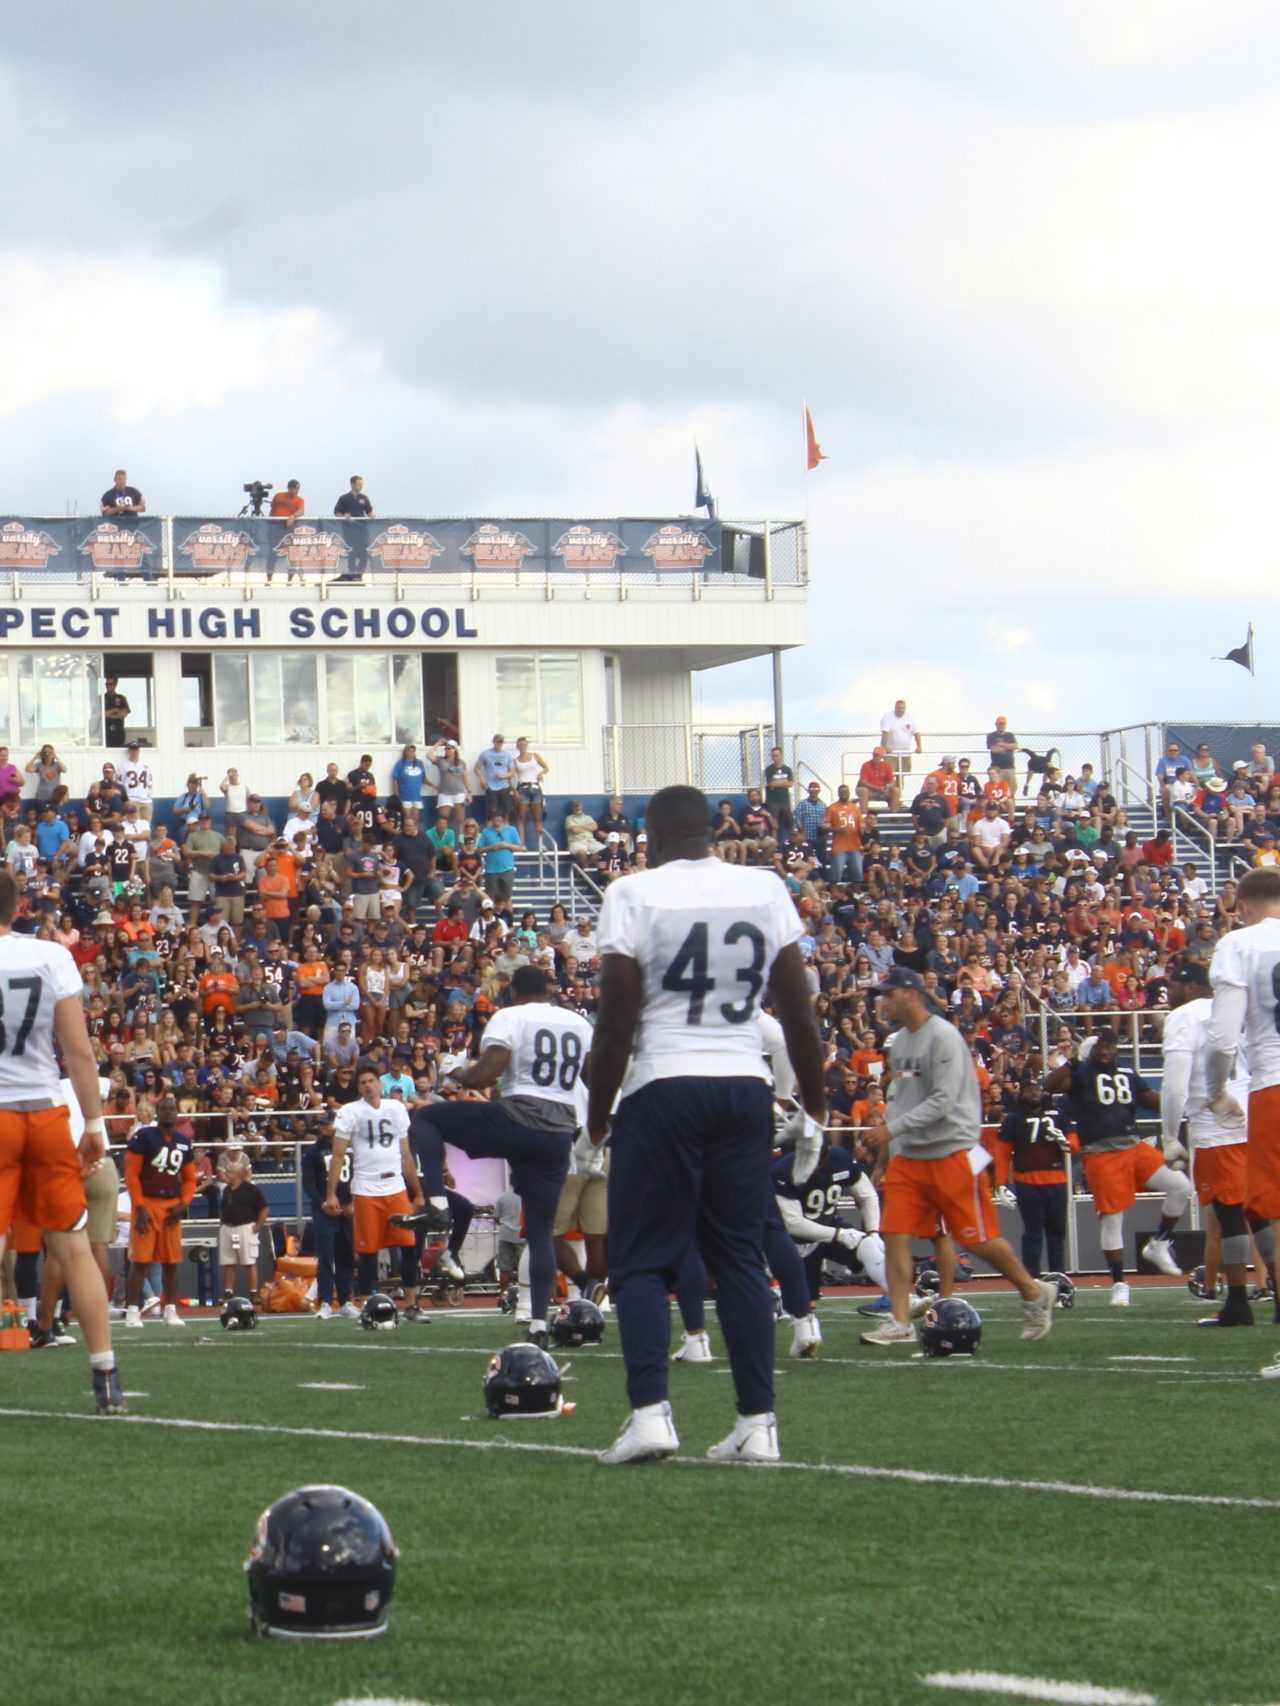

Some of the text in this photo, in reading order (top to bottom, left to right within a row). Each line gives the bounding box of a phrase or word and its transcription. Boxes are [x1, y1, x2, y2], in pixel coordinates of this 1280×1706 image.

[2, 533, 40, 545] varsity
[97, 533, 135, 545] varsity
[198, 534, 240, 546] varsity
[293, 534, 332, 546] varsity
[387, 534, 424, 547] varsity
[479, 535, 516, 546] varsity
[569, 534, 608, 547] varsity
[659, 535, 699, 547] varsity
[148, 606, 262, 640] HIGH
[290, 606, 479, 640] SCHOOL
[127, 769, 149, 790] 34
[960, 781, 976, 796] 34
[839, 810, 856, 829] 54
[114, 848, 129, 865] 22
[156, 939, 170, 955] 23
[263, 966, 283, 984] 54
[661, 921, 767, 1025] 43
[532, 1028, 582, 1091] 88
[1095, 1072, 1135, 1106] 68
[298, 1092, 311, 1110] 10
[367, 1118, 396, 1149] 16
[150, 1146, 185, 1176] 49
[805, 1184, 844, 1220] 99
